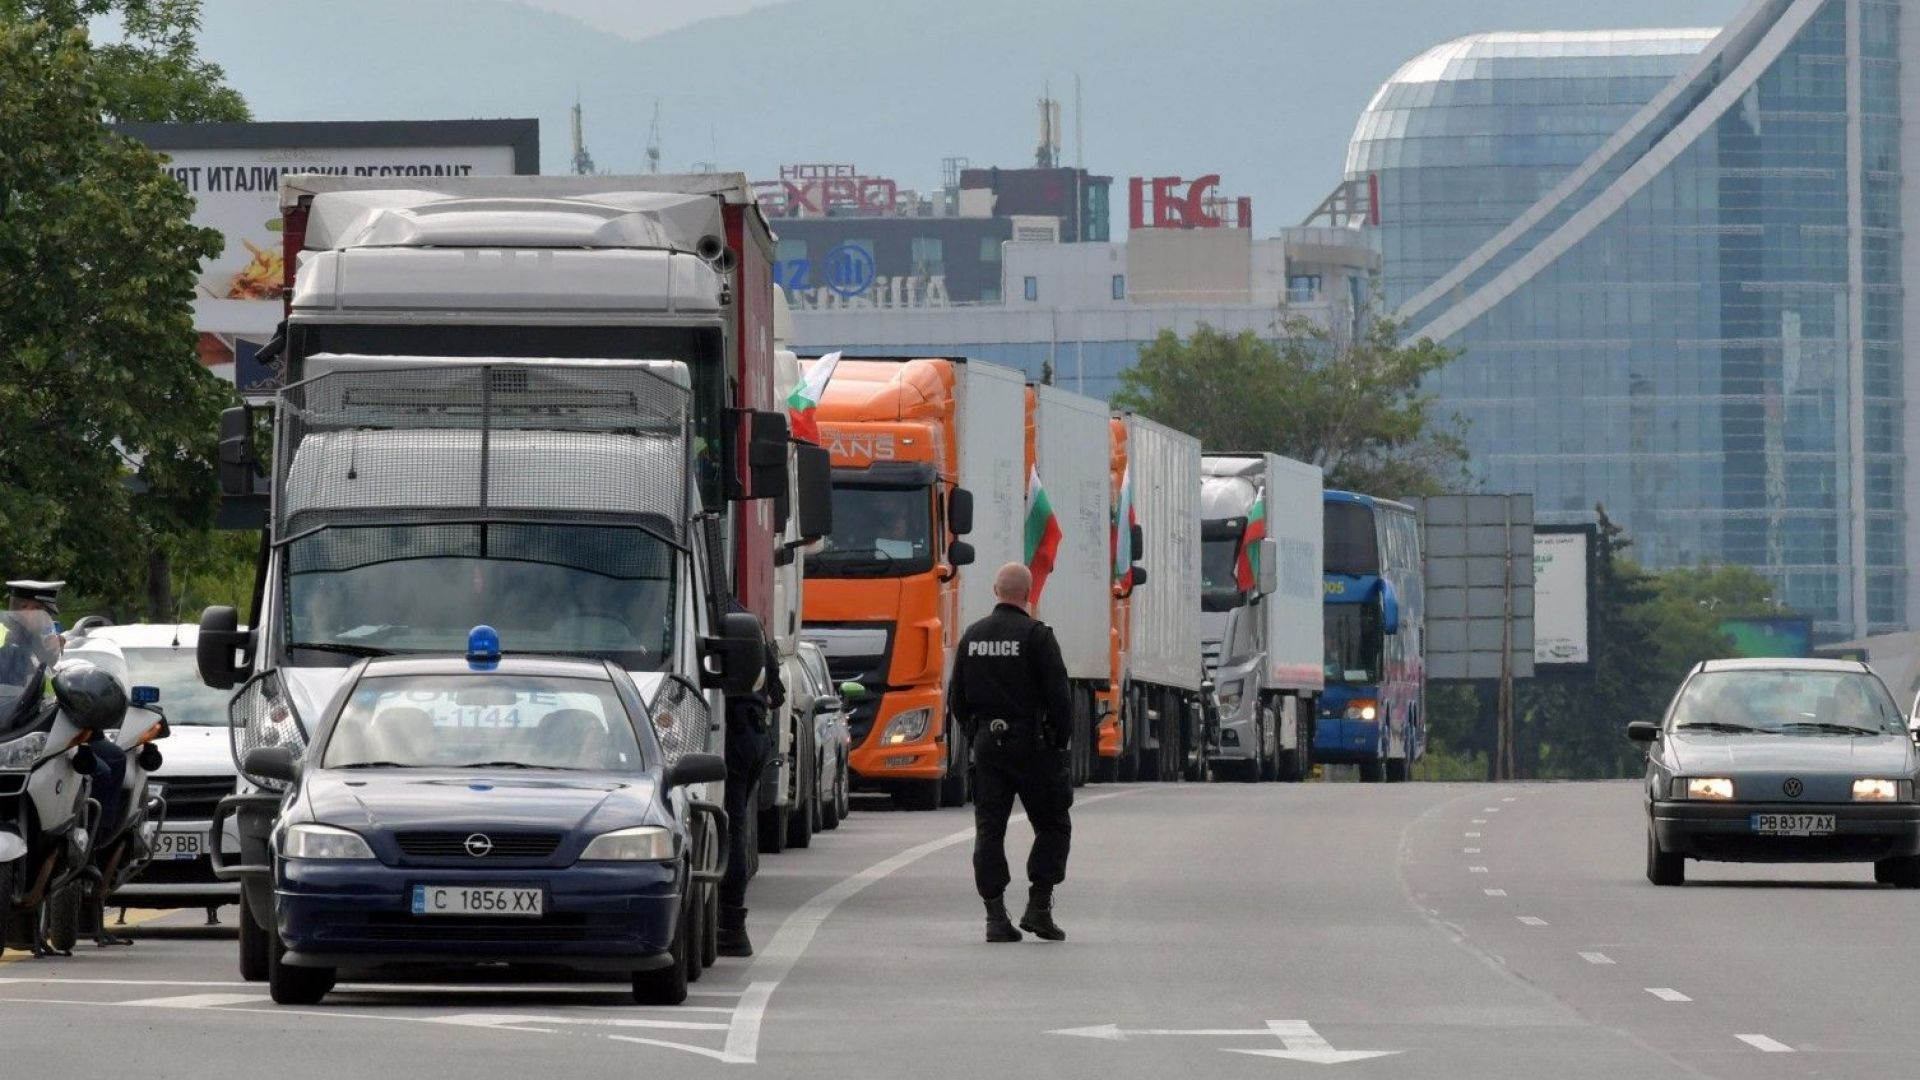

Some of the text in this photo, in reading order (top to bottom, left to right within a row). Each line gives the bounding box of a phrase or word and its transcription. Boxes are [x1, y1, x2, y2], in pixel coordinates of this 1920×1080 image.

[207, 165, 348, 192] ИТАЛИ
[780, 164, 868, 179] HOTEL
[967, 640, 1020, 656] POLICE
[1760, 815, 1833, 830] PB 8317 AX
[176, 836, 199, 852] BB
[434, 889, 448, 909] C
[461, 890, 507, 911] 1856
[512, 891, 539, 911] XX
